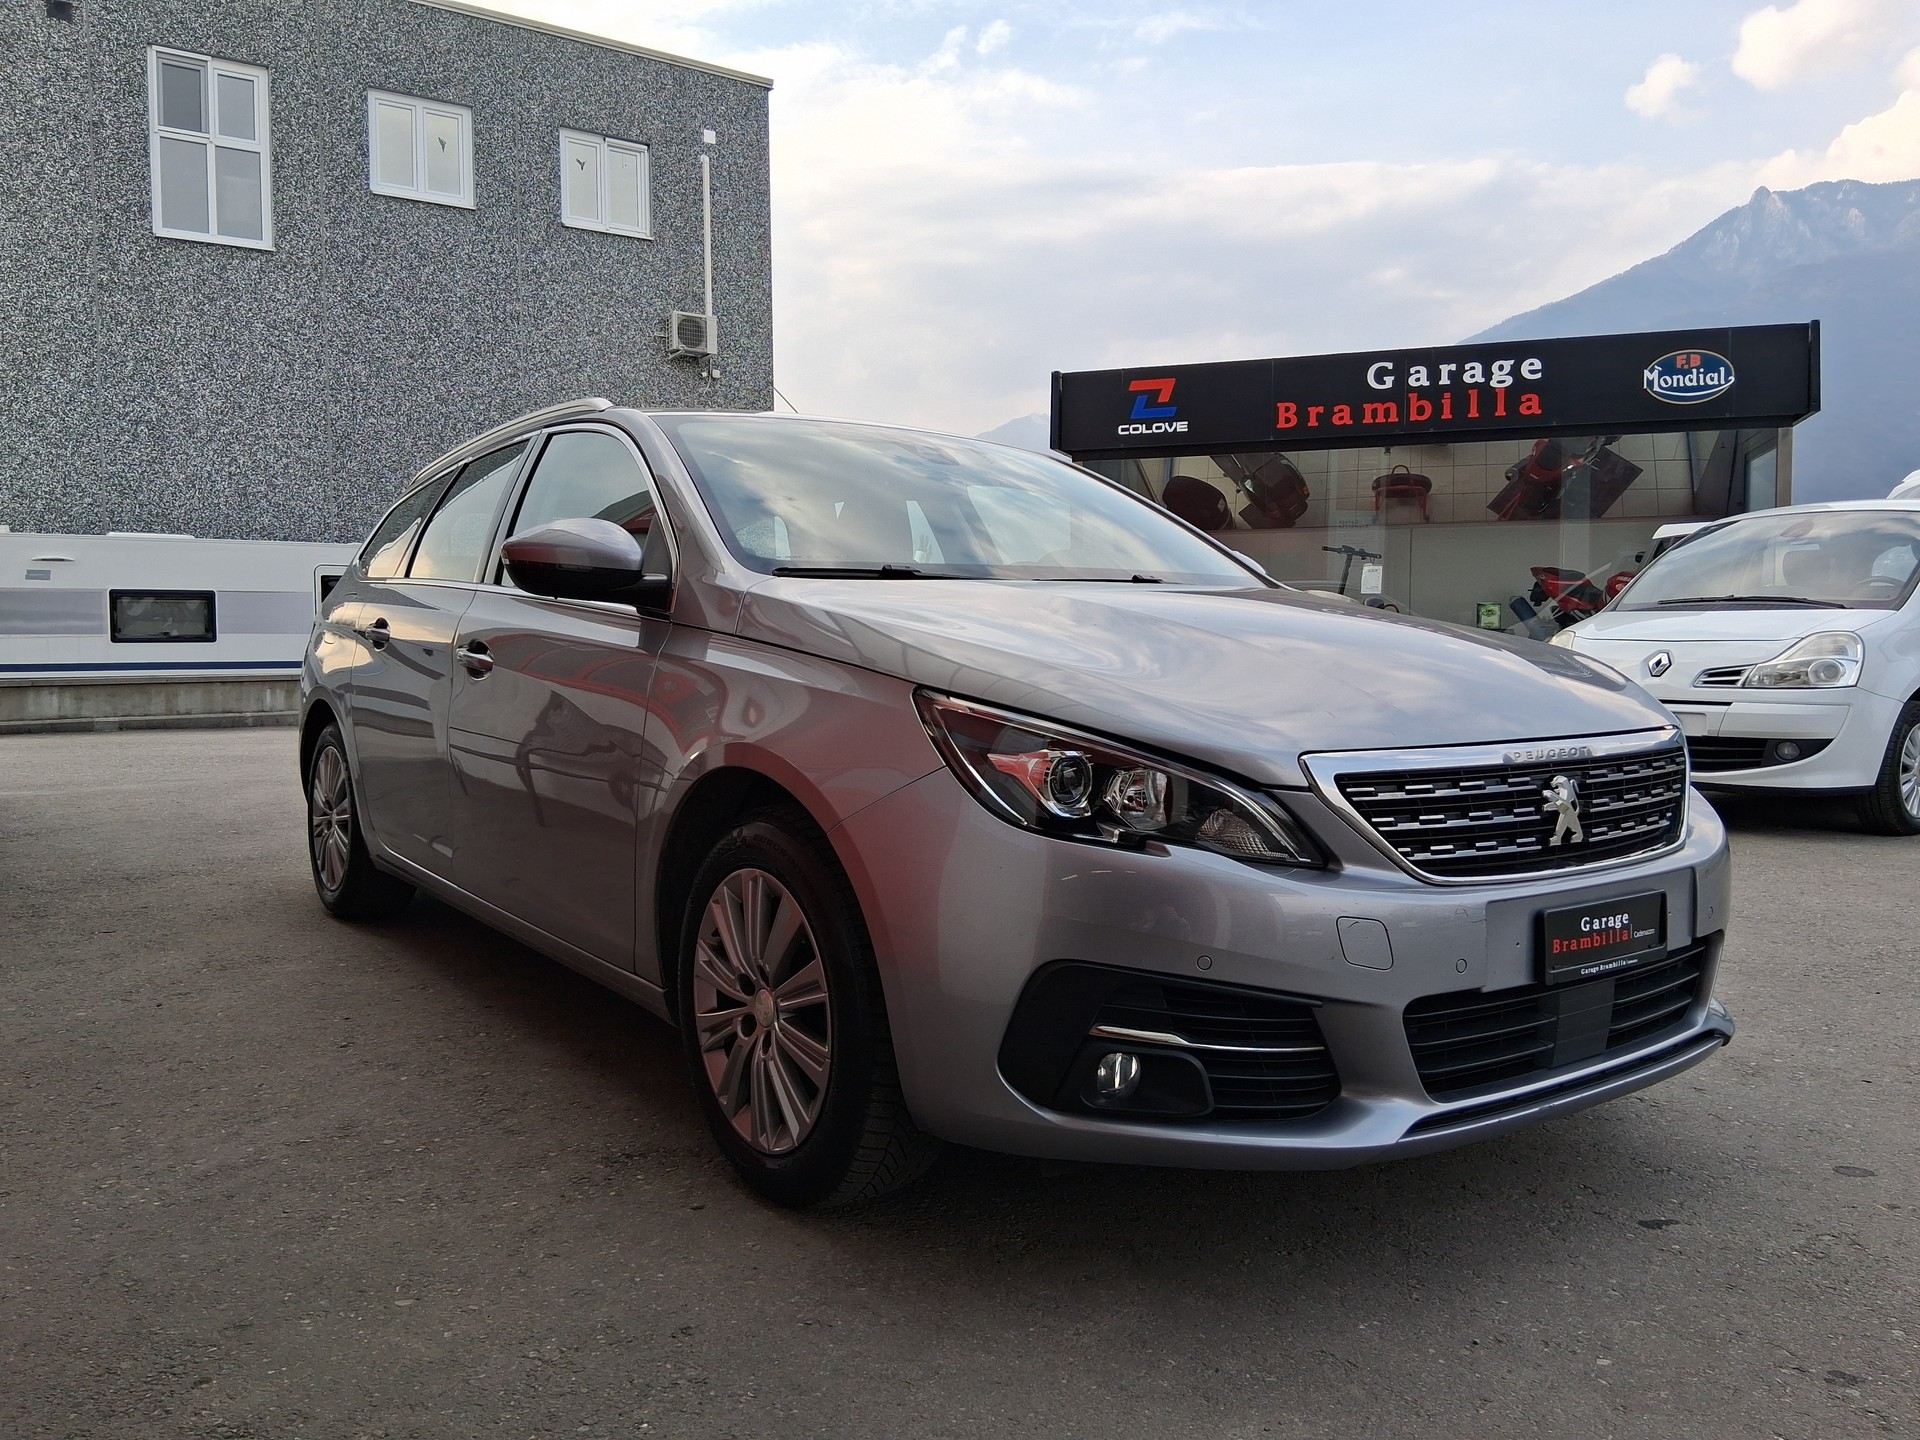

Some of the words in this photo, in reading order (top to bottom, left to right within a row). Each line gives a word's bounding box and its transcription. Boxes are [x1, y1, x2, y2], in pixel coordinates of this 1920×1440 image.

[1367, 358, 1542, 389] Garage
[1643, 365, 1735, 396] Mondial
[1276, 389, 1541, 428] Brambilla
[1117, 421, 1189, 436] COLOVE
[1513, 746, 1589, 761] PEUGEOT
[1580, 913, 1629, 931] Garage
[1552, 929, 1629, 954] Brambilla
[1580, 966, 1599, 975] Garage
[1600, 960, 1626, 970] Brambilla
